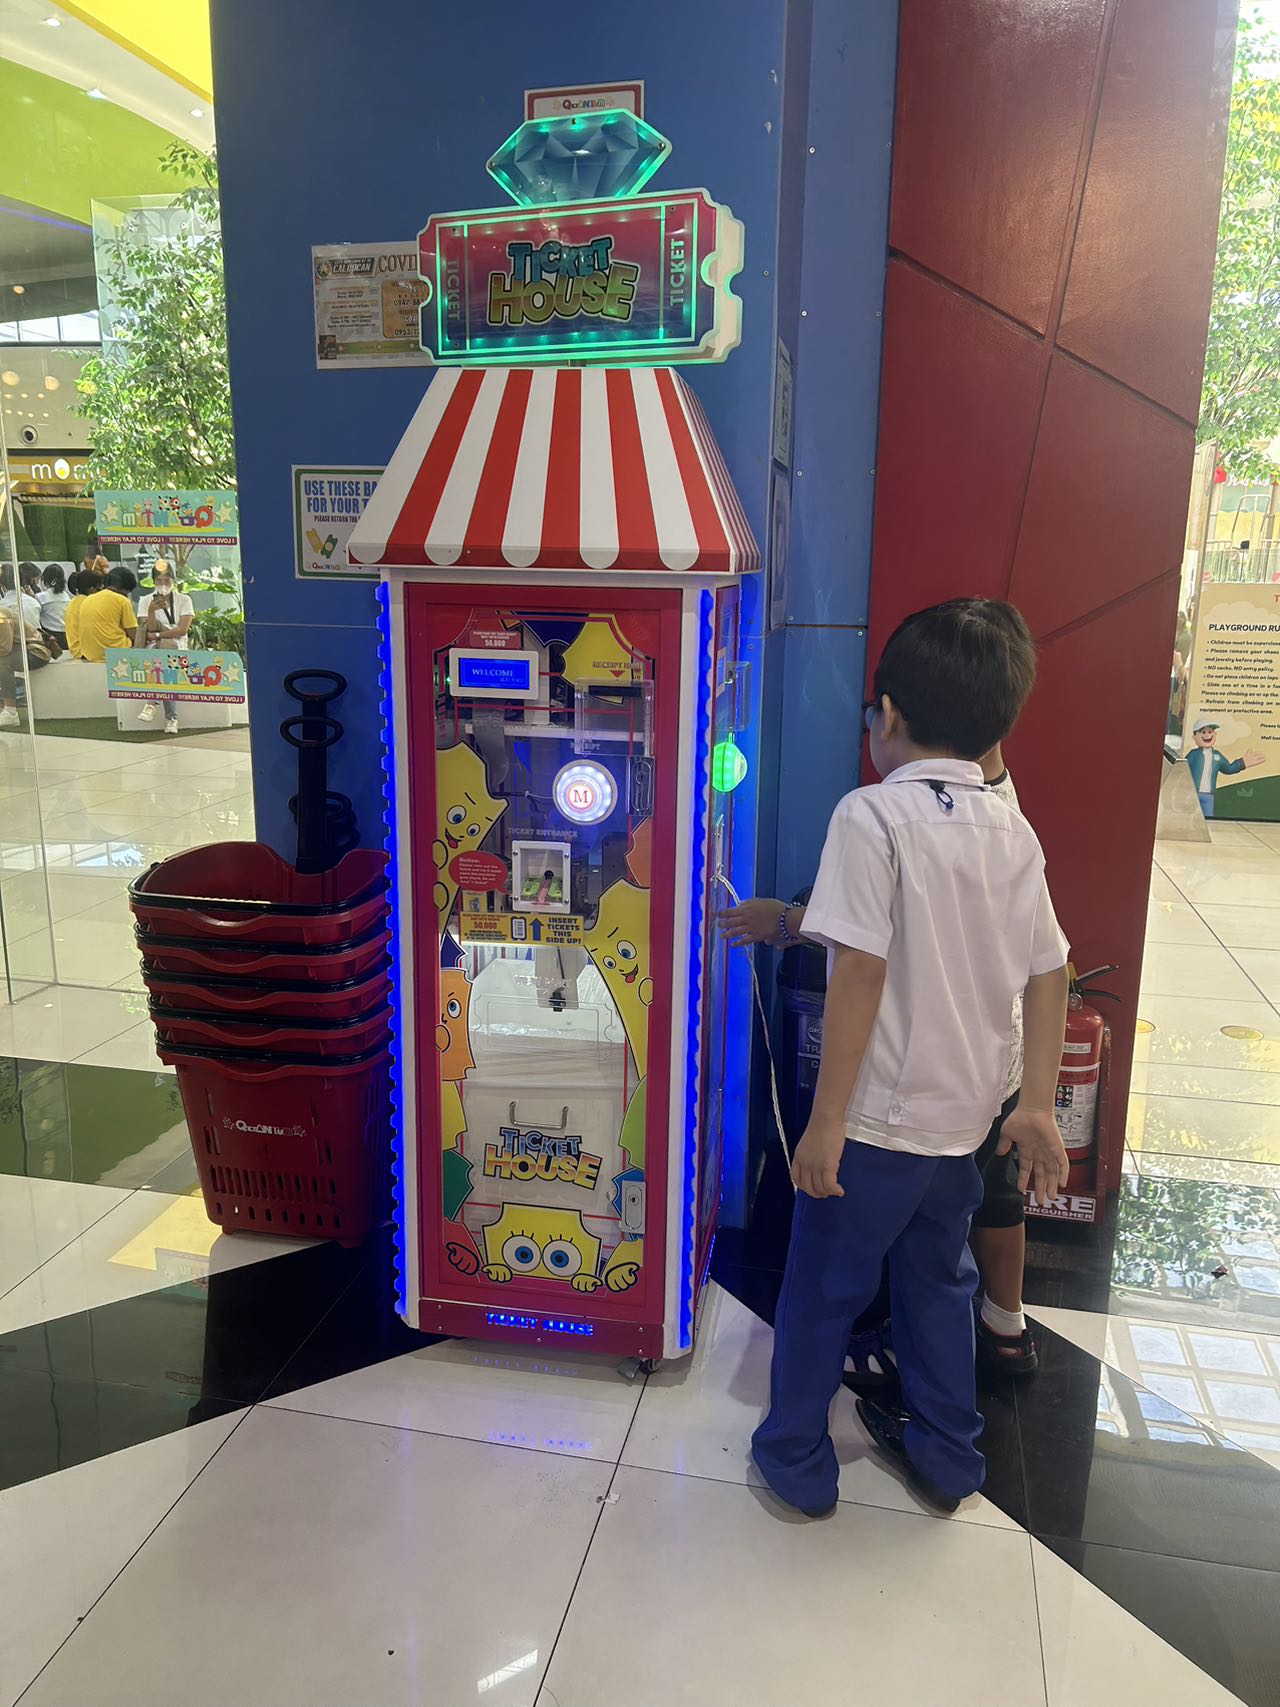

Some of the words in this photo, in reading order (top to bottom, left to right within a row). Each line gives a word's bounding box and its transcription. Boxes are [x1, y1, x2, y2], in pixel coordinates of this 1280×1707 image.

[508, 236, 612, 283] TICKET
[670, 238, 686, 307] TICKET
[448, 260, 460, 320] TICKET
[488, 262, 640, 324] HOUSE
[304, 480, 324, 496] USE
[327, 480, 360, 496] THESE
[307, 497, 327, 512] FOR
[330, 498, 359, 513] YOUR
[472, 668, 514, 677] WELCOME
[574, 790, 588, 804] M
[500, 1127, 582, 1158] TICKET
[483, 1143, 602, 1190] HOUSE
[1023, 1192, 1094, 1213] IRE
[1024, 1206, 1093, 1219] TINGUISHER
[486, 1313, 538, 1329] TICKET
[542, 1320, 593, 1336] HOUSE
